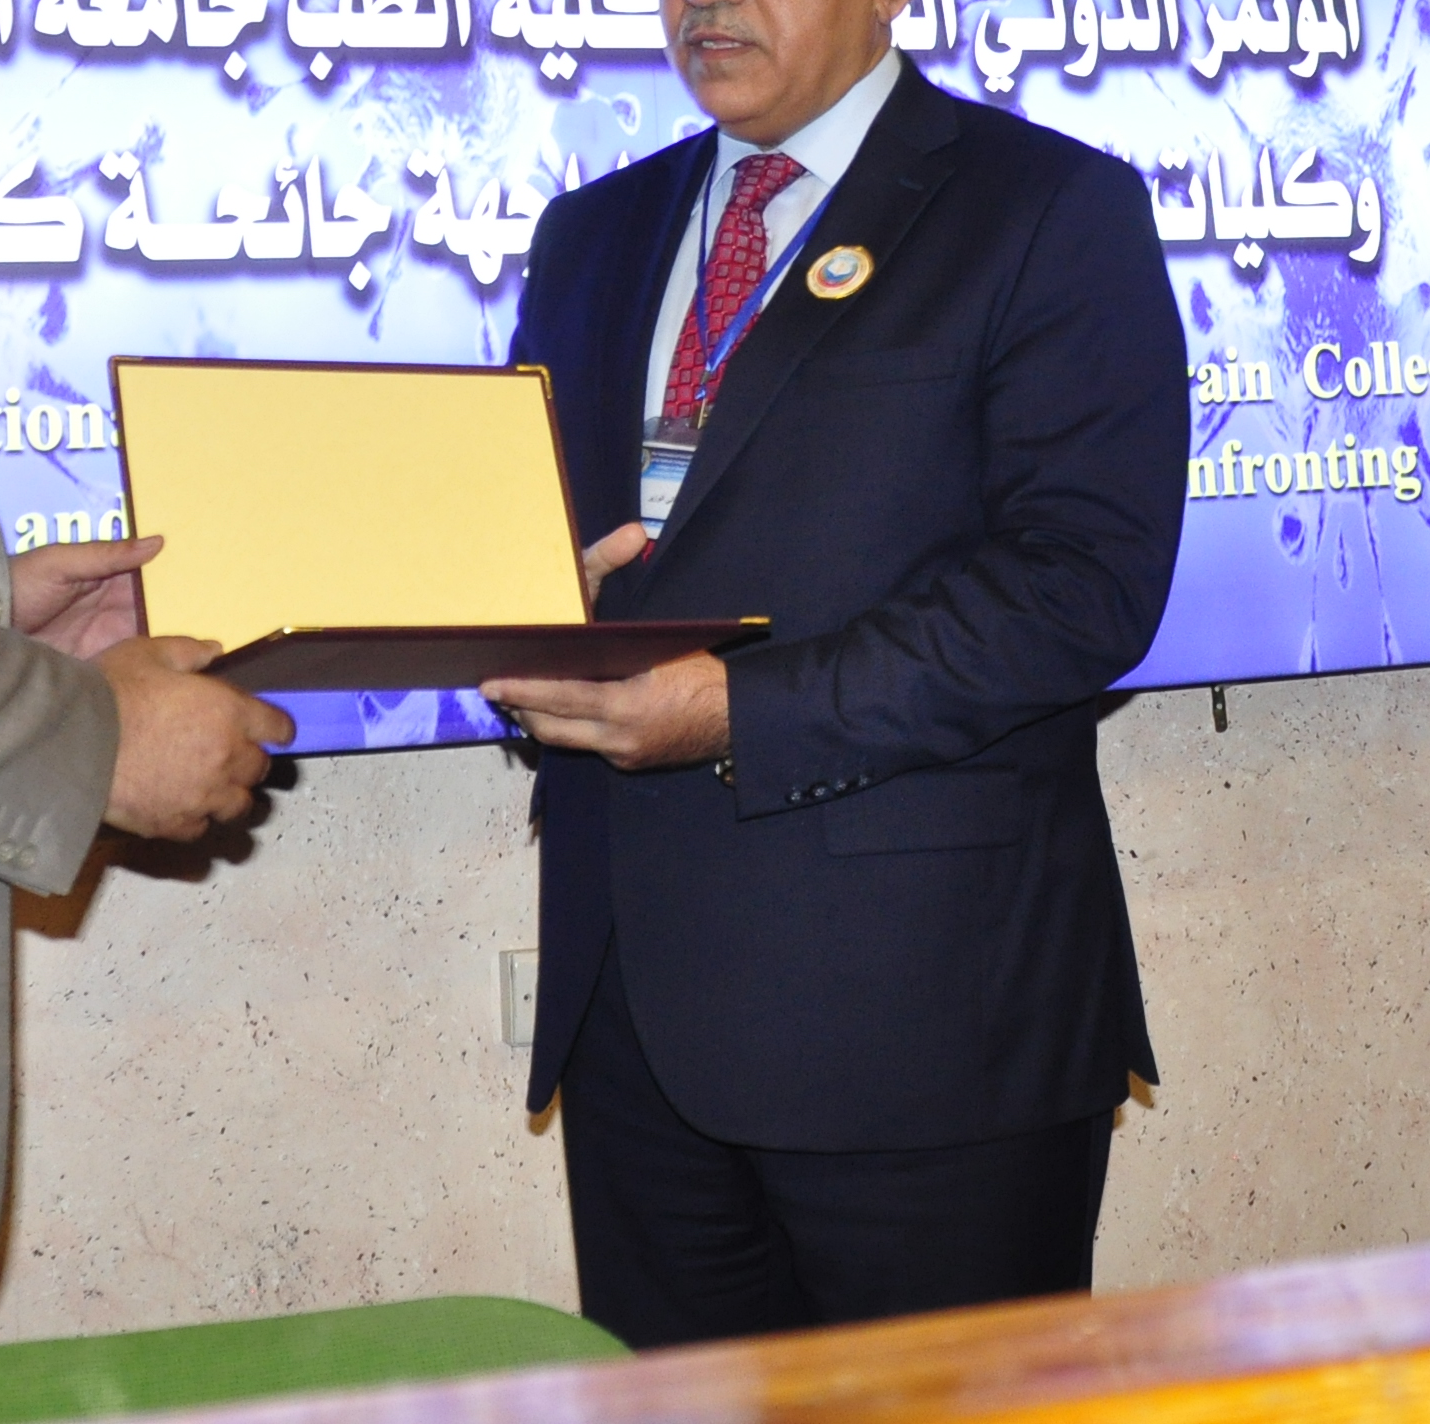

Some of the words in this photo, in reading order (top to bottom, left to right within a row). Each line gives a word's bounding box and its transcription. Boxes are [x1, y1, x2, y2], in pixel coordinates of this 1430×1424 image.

[99, 149, 391, 291] جائحة
[1151, 146, 1381, 269] وكليات
[1188, 433, 1423, 502] nfronting
